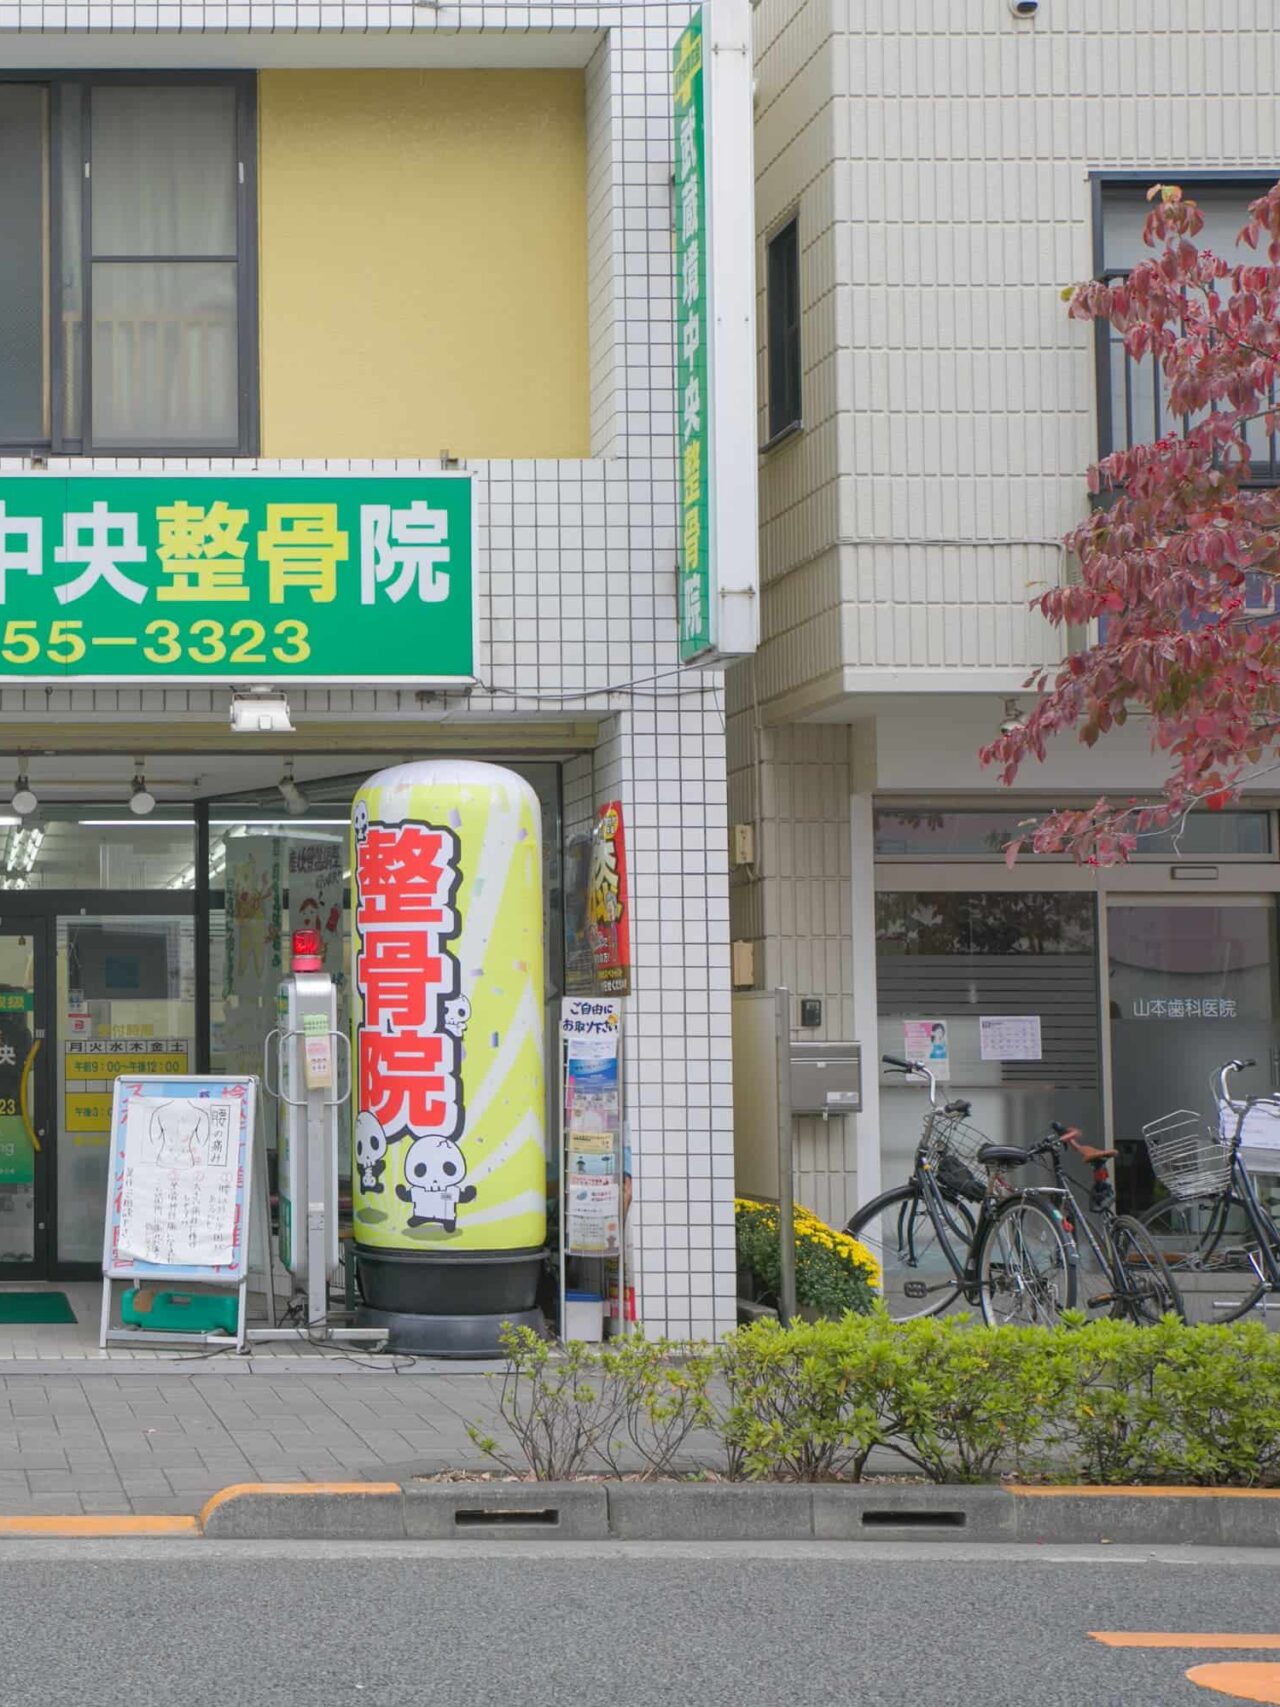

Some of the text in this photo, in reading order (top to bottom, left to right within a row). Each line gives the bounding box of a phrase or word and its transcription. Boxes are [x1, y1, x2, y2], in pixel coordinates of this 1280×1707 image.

[357, 827, 448, 1130] 整骨院
[571, 1002, 613, 1015] ご自由に
[1133, 998, 1237, 1018] 山本歯科医院
[563, 1019, 618, 1034] お取り下さい
[70, 1042, 183, 1052] 月 火 水 木 金 土
